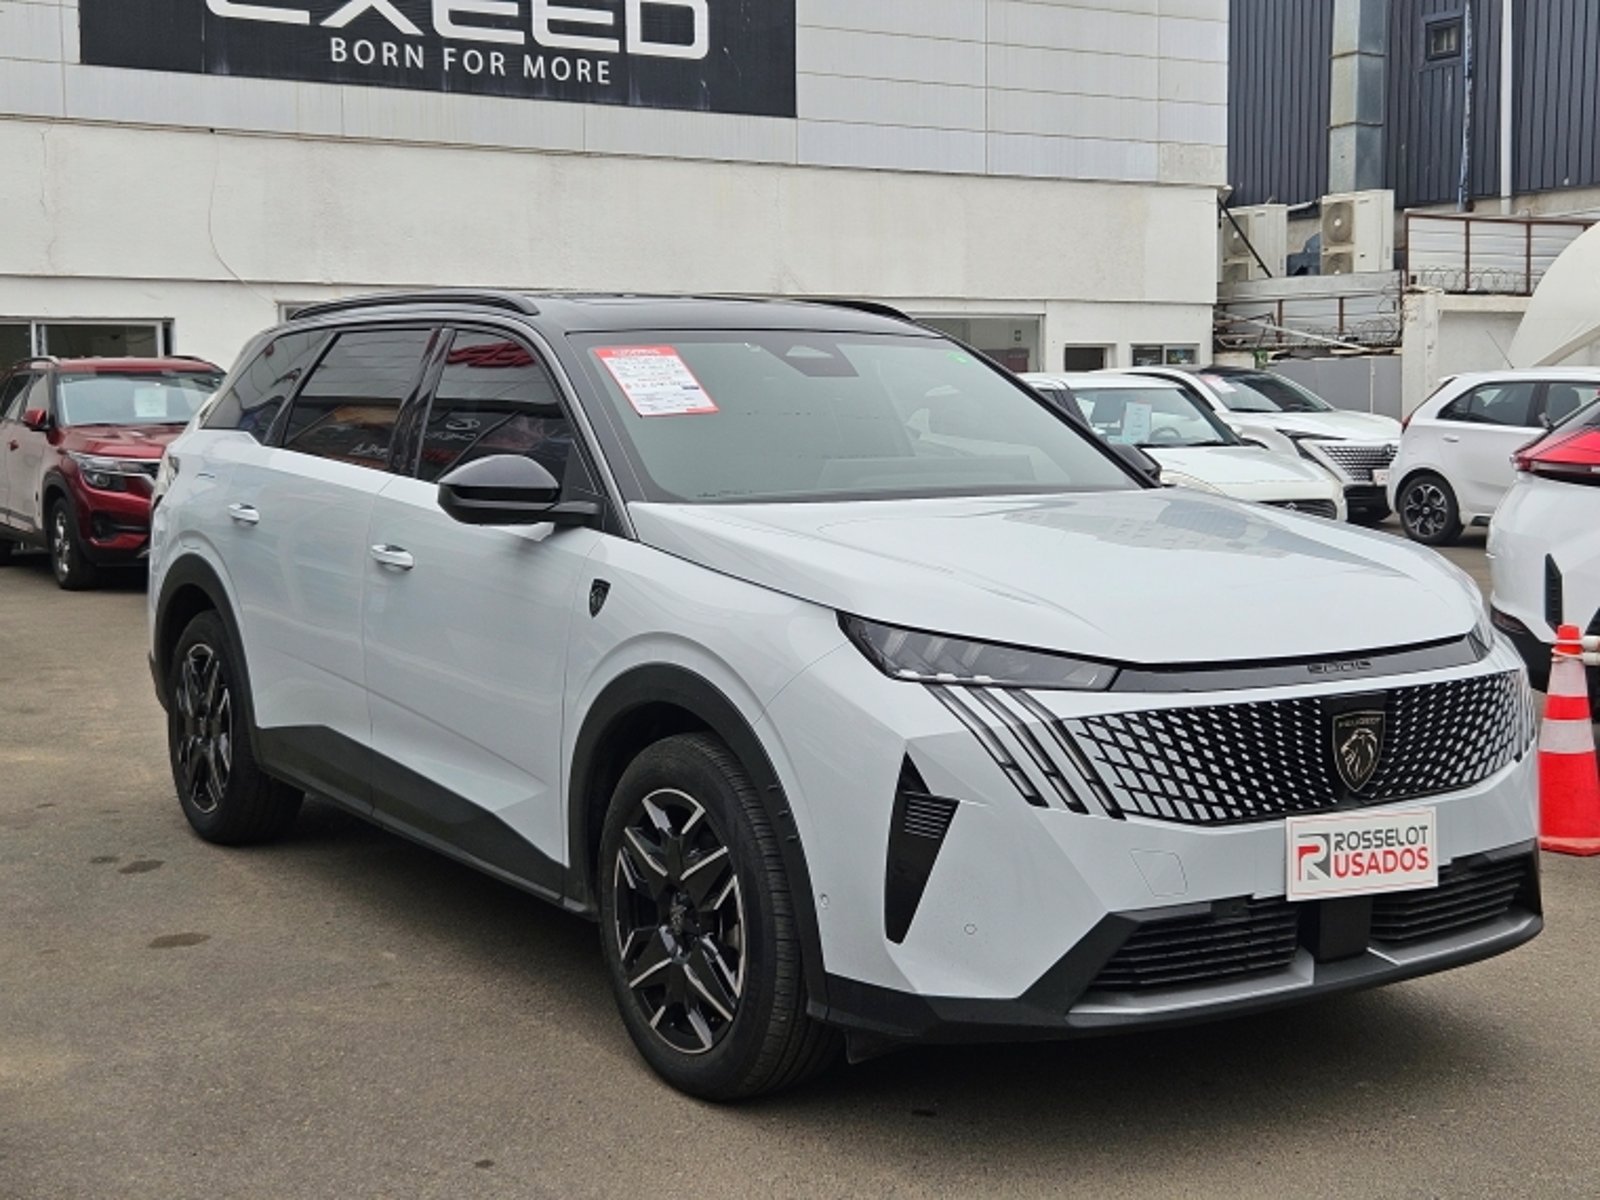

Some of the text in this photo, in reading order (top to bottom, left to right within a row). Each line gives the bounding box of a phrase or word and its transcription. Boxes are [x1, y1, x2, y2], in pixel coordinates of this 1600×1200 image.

[330, 37, 611, 85] BORN FOR MORE
[1334, 825, 1428, 852] ROSSELOT
[1334, 847, 1429, 878] USADOS
